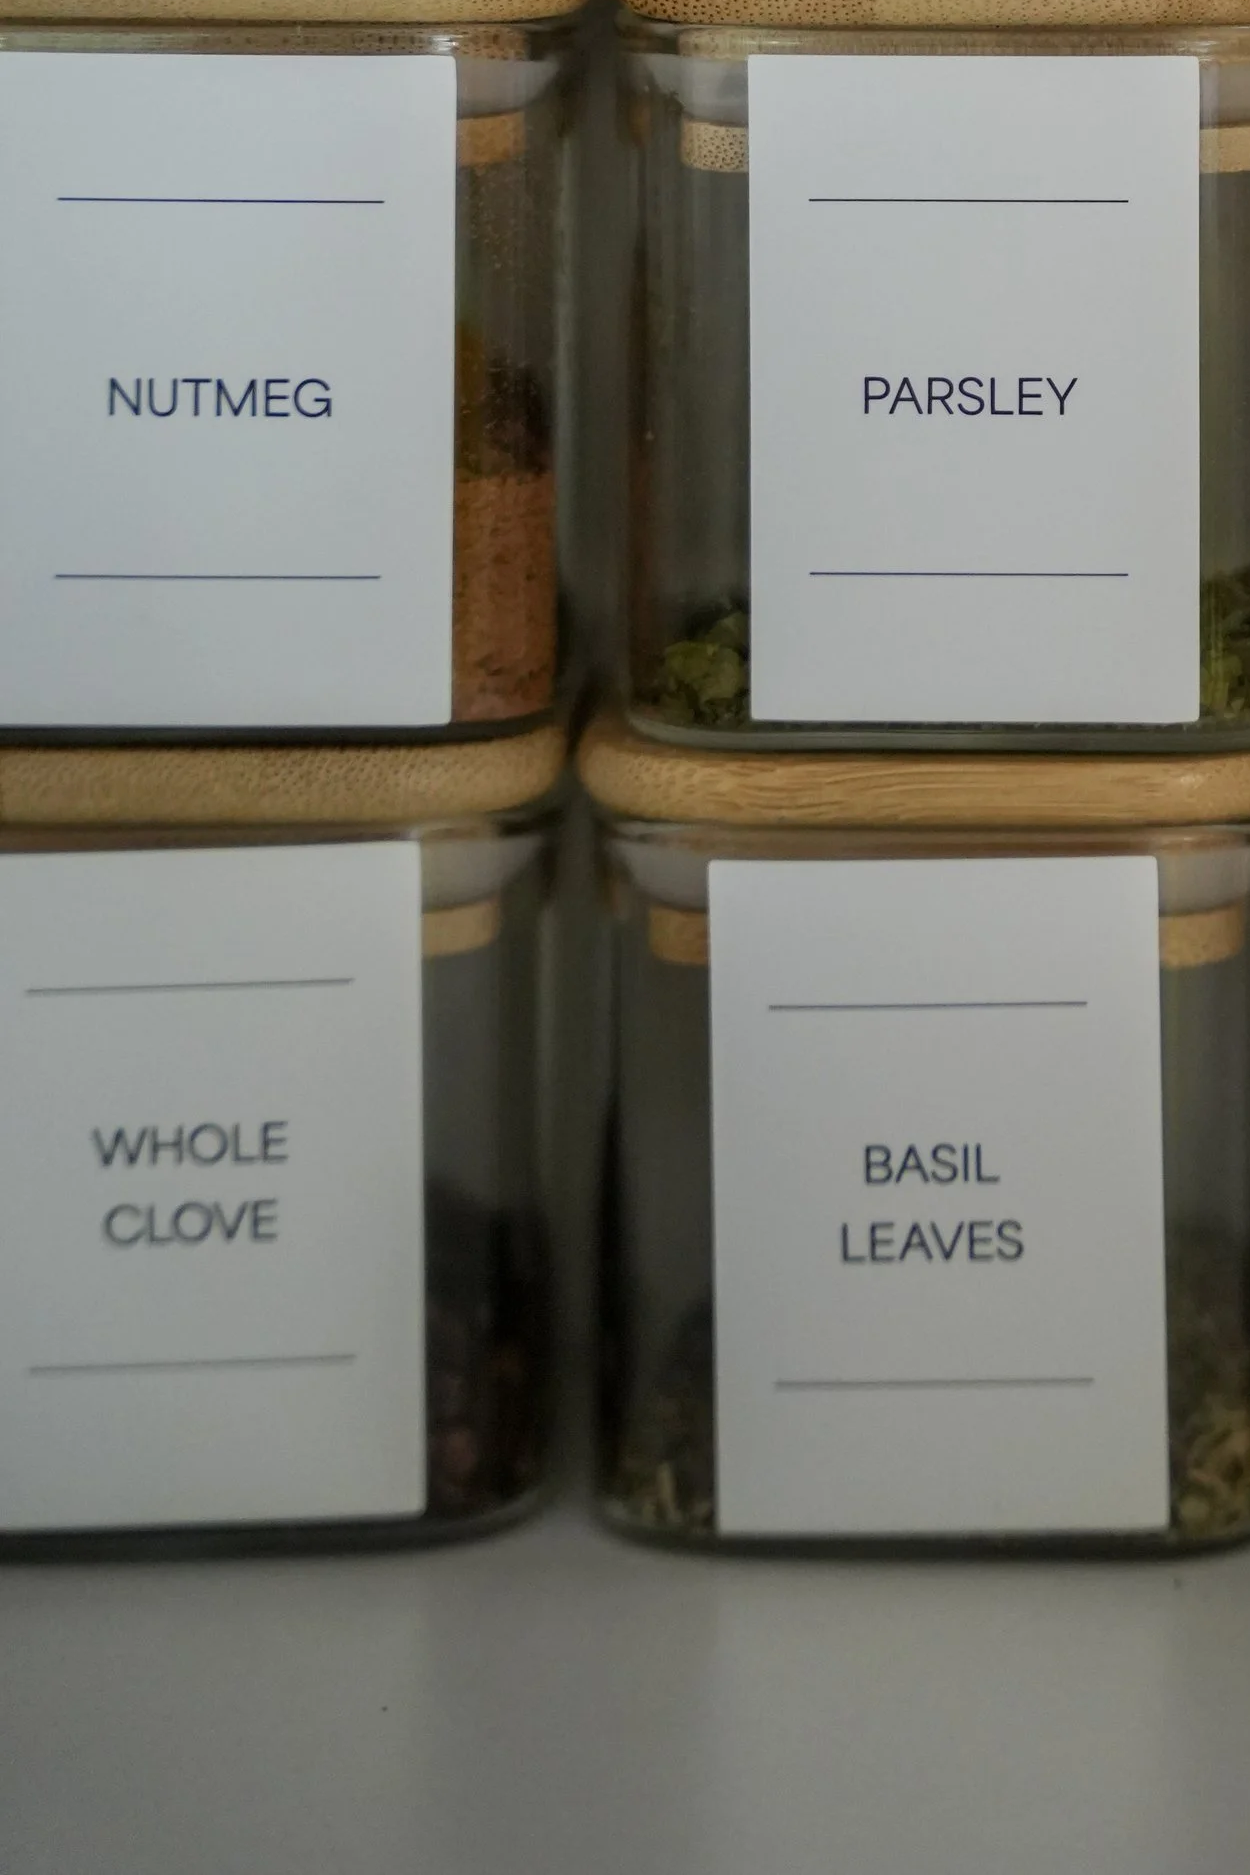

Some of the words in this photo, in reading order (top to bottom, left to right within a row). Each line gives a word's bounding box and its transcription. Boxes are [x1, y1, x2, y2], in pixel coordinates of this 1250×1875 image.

[108, 377, 332, 418] NUTMEG
[864, 377, 1078, 416] PARSLEY
[93, 1121, 288, 1168] WHOLE
[863, 1143, 1000, 1185] BASIL
[103, 1199, 277, 1246] CLOVE
[841, 1220, 1024, 1263] LEAVES
